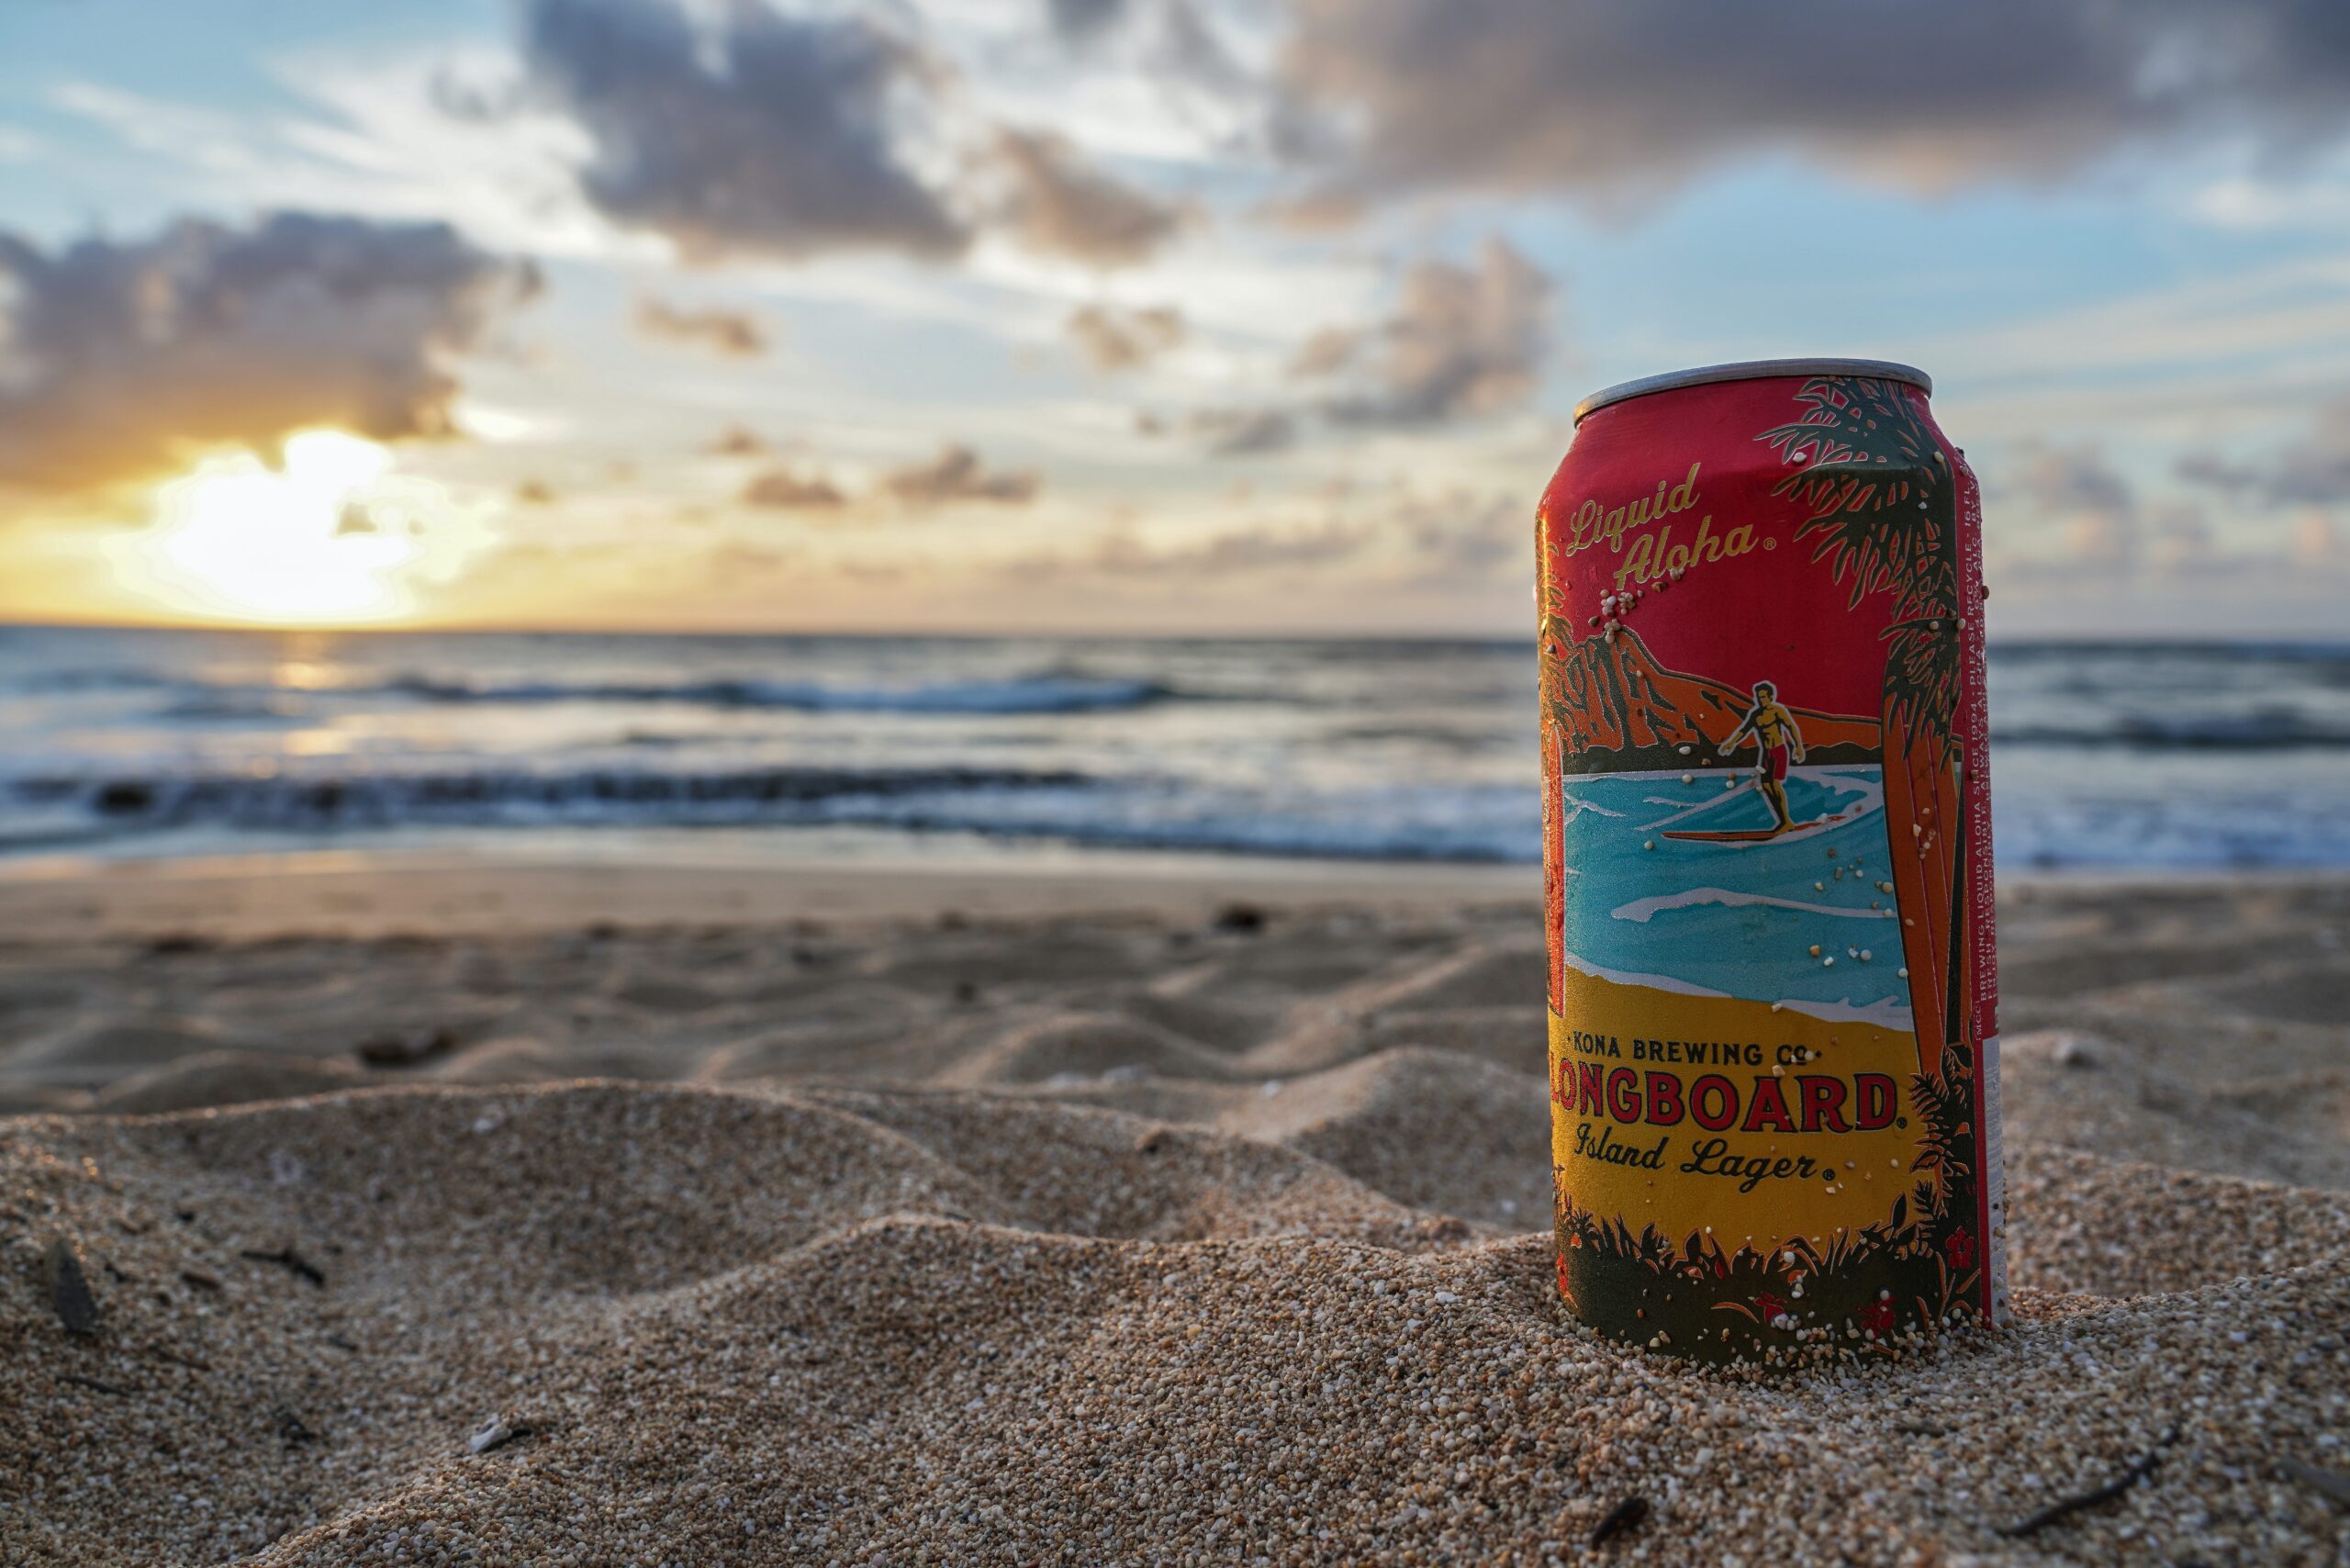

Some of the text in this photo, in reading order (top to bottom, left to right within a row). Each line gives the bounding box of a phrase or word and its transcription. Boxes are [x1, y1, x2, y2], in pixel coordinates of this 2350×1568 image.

[1565, 462, 1701, 556] Liquid
[1613, 515, 1759, 591] Aloha
[1965, 543, 1975, 616] RECYCLE
[1968, 622, 1976, 686] PLEASE
[1978, 924, 1986, 1002] BREWING
[1573, 1030, 1621, 1058] KONA
[1633, 1040, 1763, 1066] BREWING
[1574, 1123, 1818, 1193] Island Lager
